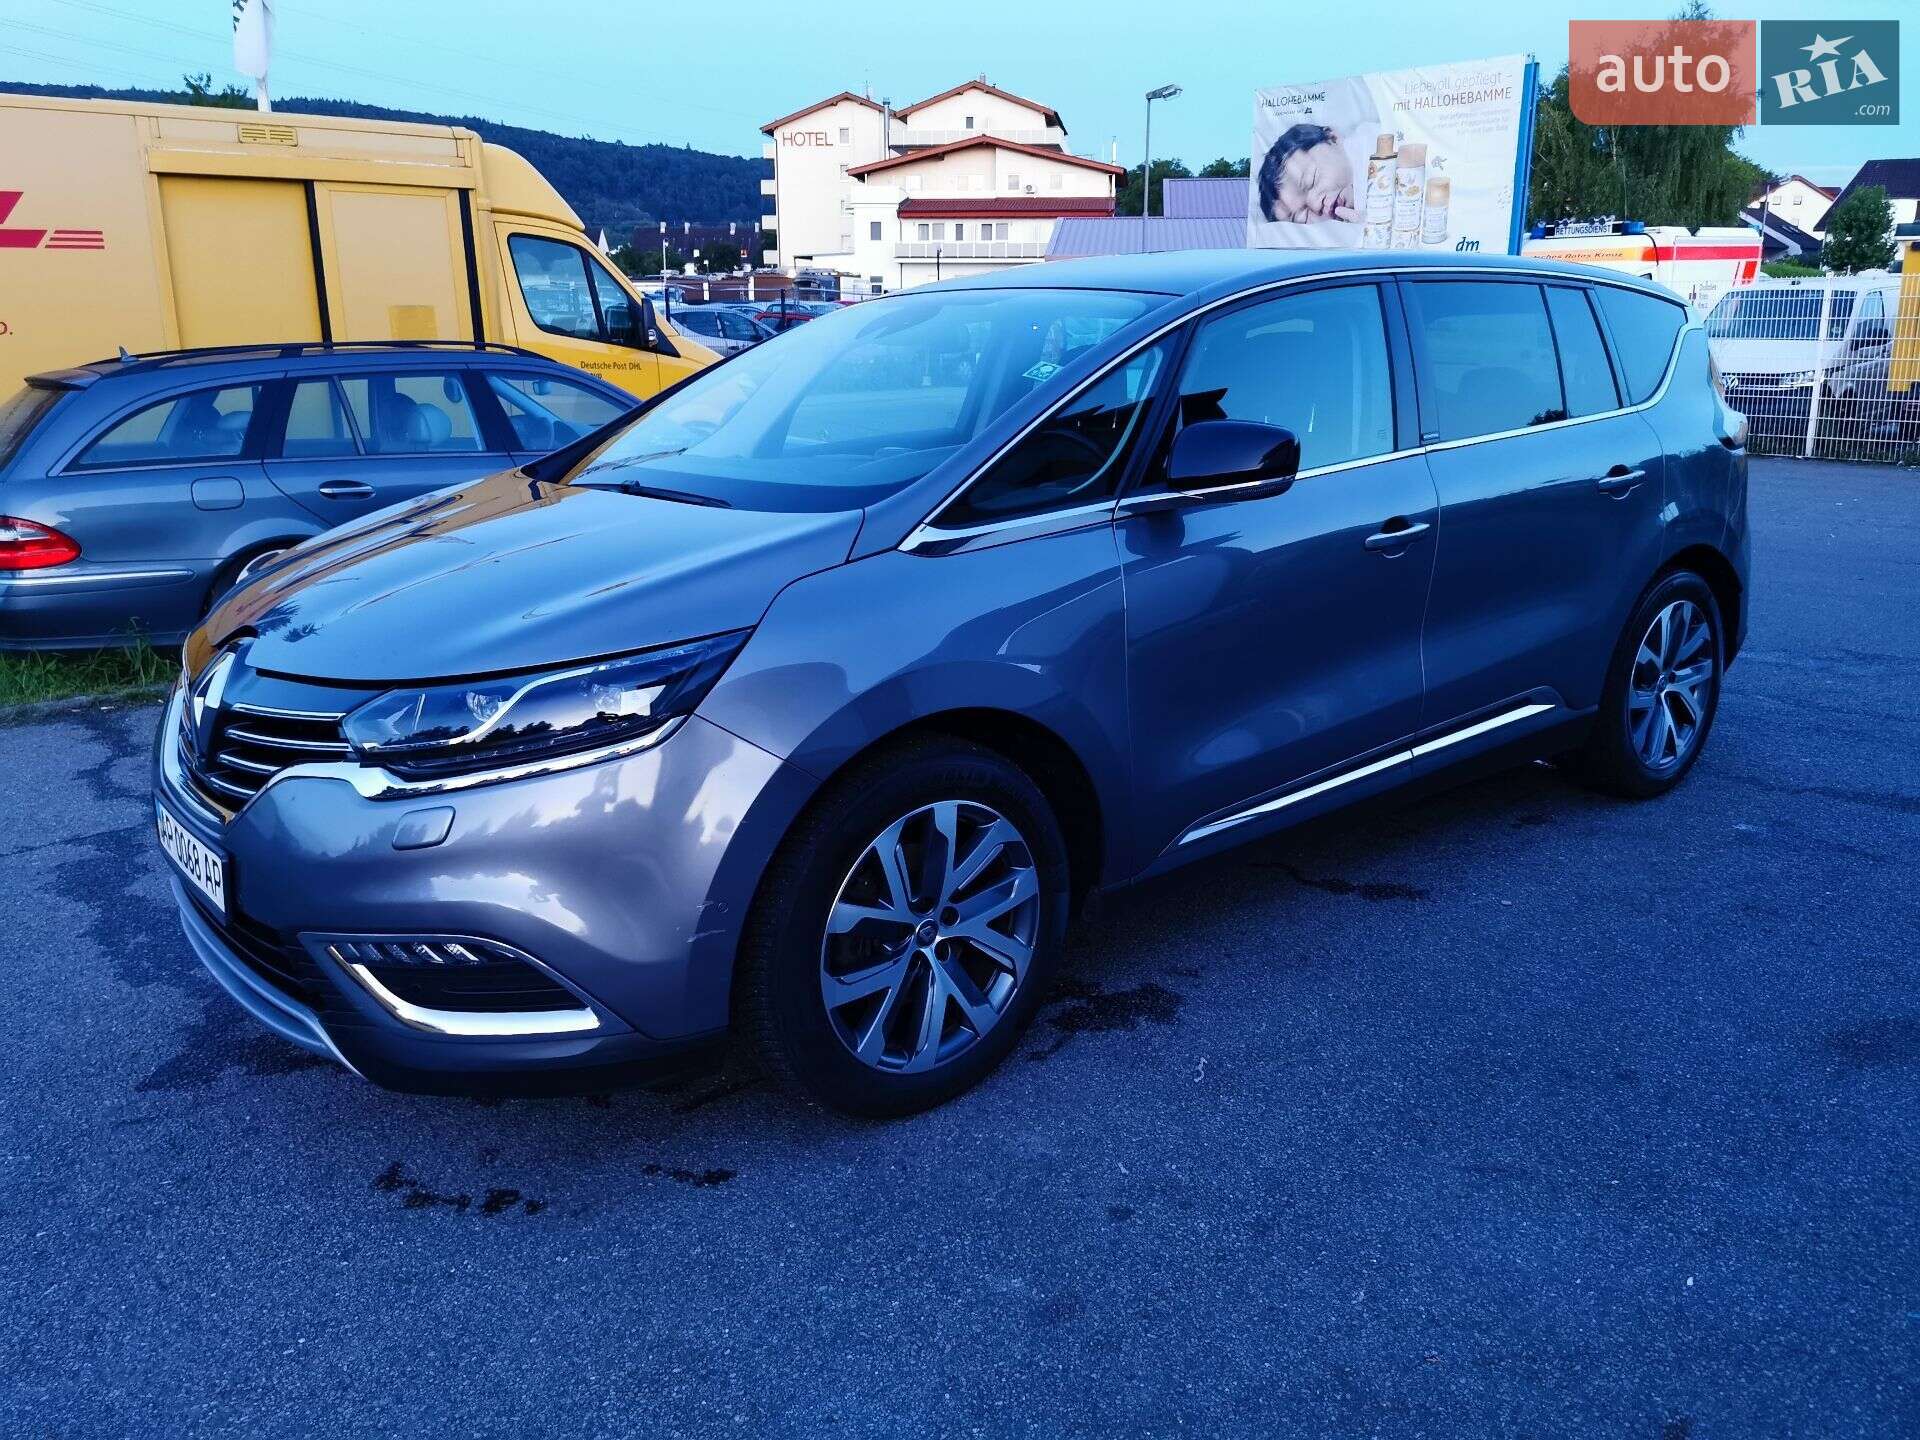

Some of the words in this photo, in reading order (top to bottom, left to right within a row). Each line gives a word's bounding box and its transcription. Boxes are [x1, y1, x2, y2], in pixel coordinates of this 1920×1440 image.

[1261, 91, 1326, 108] HALLOHEBAMME
[1393, 100, 1411, 111] mit
[1414, 87, 1512, 109] HALLOHEBAMME
[782, 131, 834, 147] HOTEL
[1556, 224, 1611, 235] RETTUNGSDIENST
[1455, 236, 1480, 252] dm
[580, 360, 612, 370] Deutsche
[613, 361, 627, 370] Post
[628, 361, 642, 371] DHL
[204, 852, 222, 897] AP
